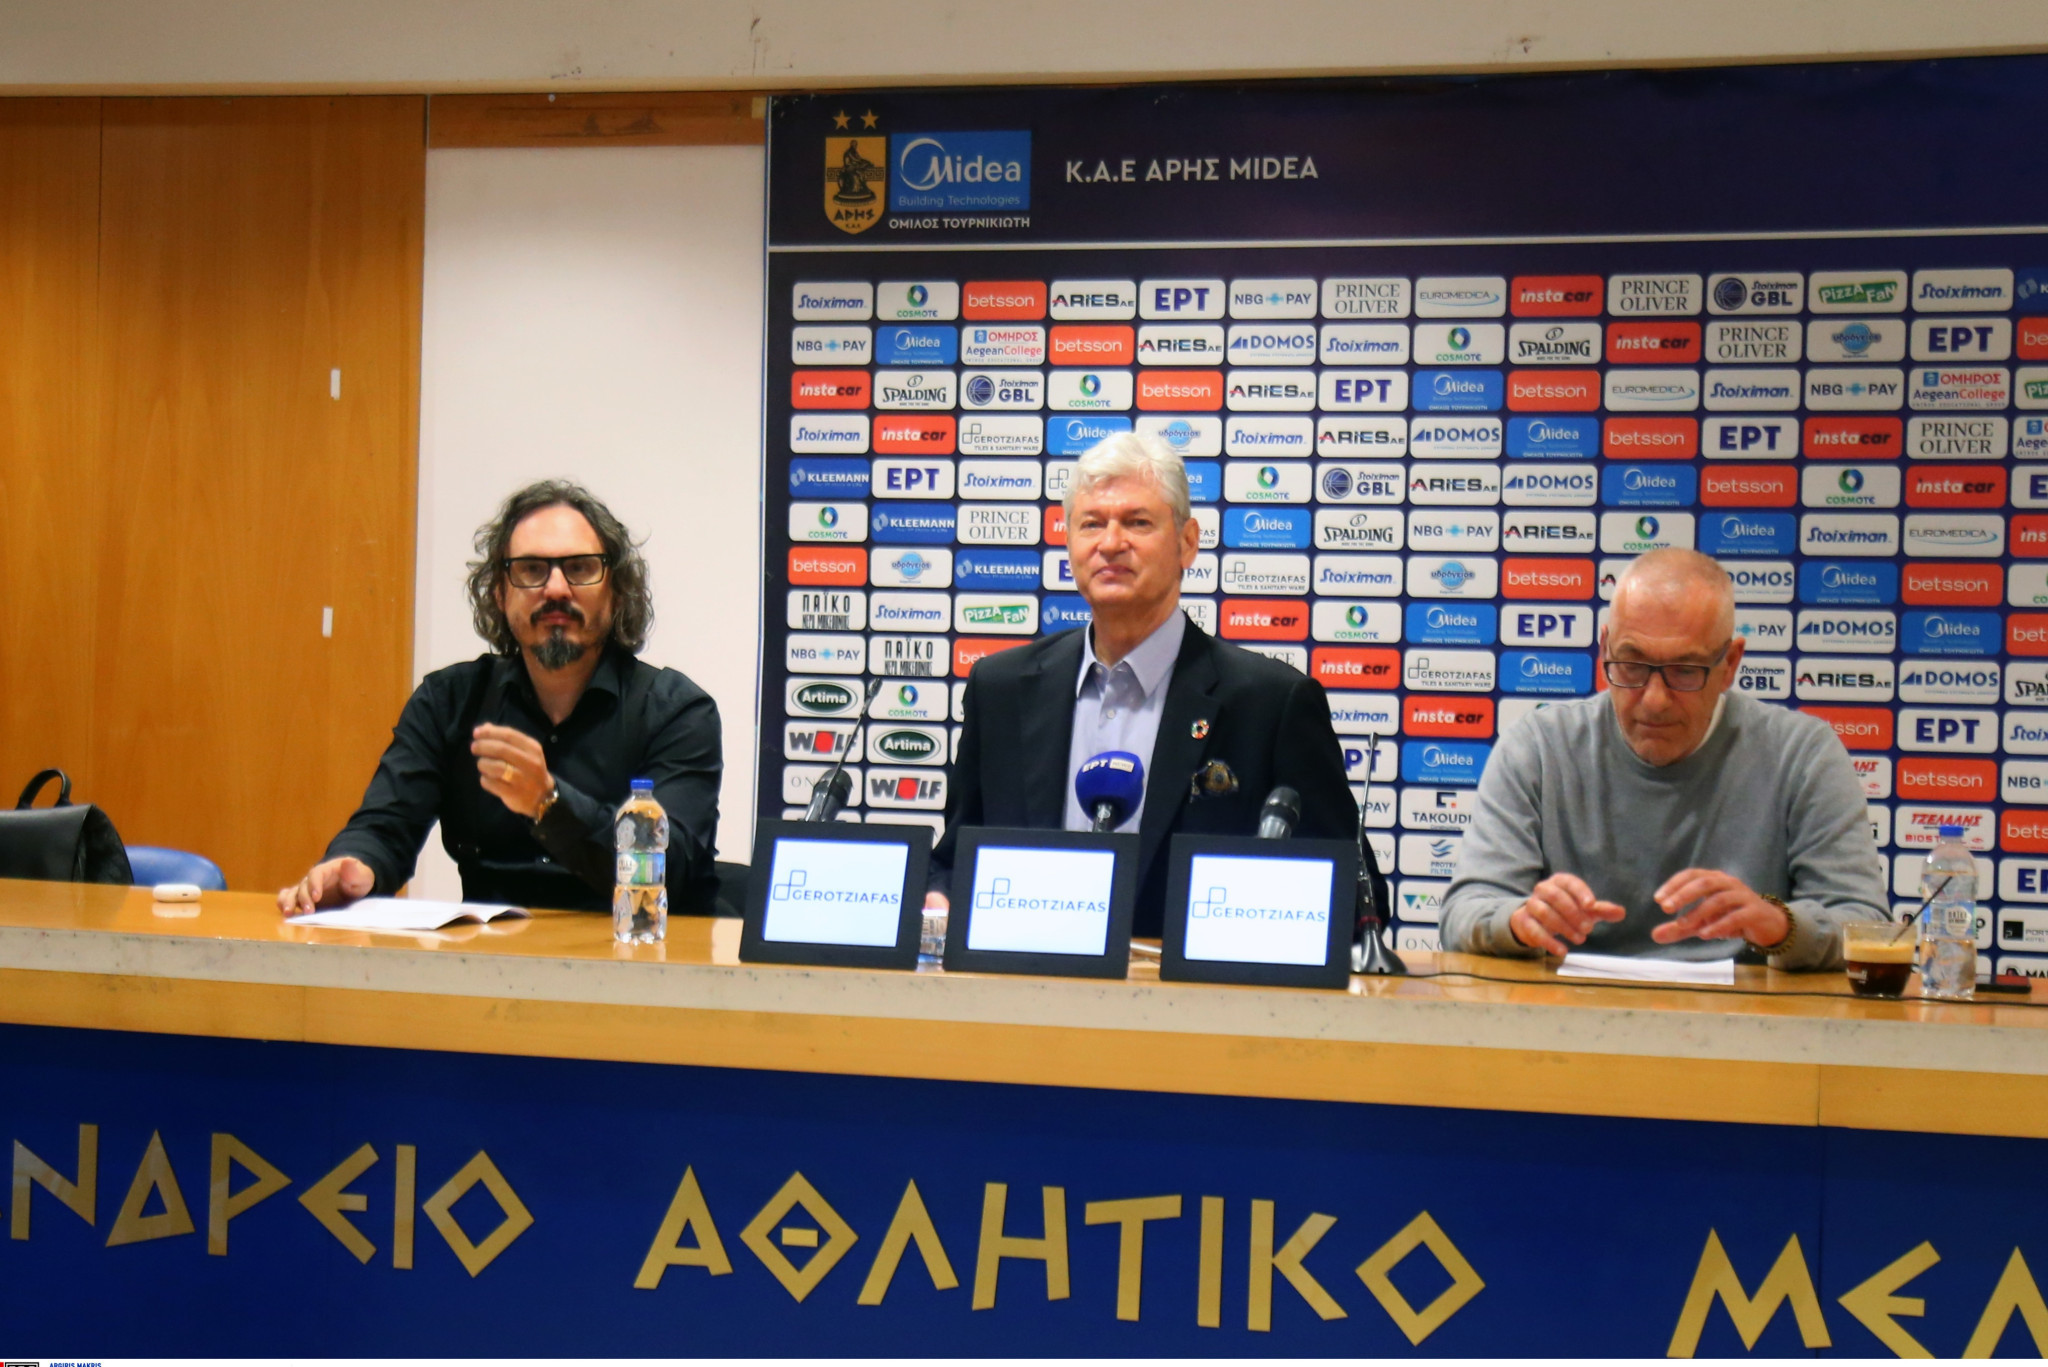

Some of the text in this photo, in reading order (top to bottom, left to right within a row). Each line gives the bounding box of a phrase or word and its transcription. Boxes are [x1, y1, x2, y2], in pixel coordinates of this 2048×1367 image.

[907, 142, 1021, 187] Midea
[1146, 159, 1220, 182] ΑΡΗΣ
[1230, 156, 1319, 179] MIDEA
[899, 195, 1020, 207] Building Technologies
[889, 217, 1030, 229] ΟΜΙΛΟΣ ΤΟΥΡΝΙΚΙΩΤΗ
[1336, 284, 1400, 298] PRINCE
[1622, 281, 1689, 294] PRINCE
[1919, 284, 2003, 299] Stoiximan
[798, 293, 864, 309] Stoiximan
[968, 294, 1034, 308] betsson
[1154, 288, 1210, 312] ΕΡΤ
[1235, 293, 1311, 305] NBG PAY
[1420, 291, 1490, 301] EUROMEDICA
[1521, 289, 1593, 302] instacar
[1751, 292, 1793, 306] GBL
[1335, 300, 1398, 314] OLIVER
[1621, 297, 1688, 311] OLIVER
[897, 310, 938, 318] COSMOTE
[898, 332, 940, 349] Midea
[988, 332, 1038, 342] ΟΜΗΡΟΣ
[1720, 327, 1789, 342] PRINCE
[1929, 327, 1993, 353] ΕΡΤ
[797, 340, 866, 351] NBG PAY
[1055, 339, 1122, 352] betsson
[1251, 336, 1314, 349] DOMOS
[1326, 338, 1399, 353] Stoiximan
[1518, 340, 1590, 357] SPALDING
[1616, 335, 1690, 349] instacar
[1436, 354, 1482, 362] COSMOTE
[1718, 344, 1787, 358] OLIVER
[1436, 376, 1484, 395] Midea
[1940, 373, 2001, 385] ΟΜΗΡΟΣ
[800, 383, 861, 396] instacar
[883, 386, 947, 403] SPALDING
[999, 389, 1034, 402] GBL
[1142, 384, 1211, 398] betsson
[1335, 380, 1392, 403] ΕΡΤ
[1513, 384, 1587, 398] betsson
[1710, 383, 1790, 398] Stoiximan
[1811, 384, 1897, 395] NBG PAY
[1069, 400, 1111, 408] COSMOTE
[796, 428, 860, 442] Stoiximan
[882, 428, 946, 442] instacar
[1434, 428, 1500, 442] DOMOS
[1529, 422, 1579, 441] Midea
[1814, 430, 1891, 444] instacar
[1922, 423, 1993, 437] PRINCE
[1232, 430, 1304, 445] Stoiximan
[1610, 431, 1684, 445] betsson
[1720, 426, 1781, 450] ΕΡΤ
[1920, 440, 1991, 454] OLIVER
[808, 473, 869, 483] KLEEMANN
[888, 468, 939, 490] ΕΡΤ
[964, 473, 1032, 488] Stoiximan
[1527, 475, 1593, 489] DOMOS
[1625, 470, 1675, 489] Midea
[1357, 482, 1395, 496] GBL
[1707, 479, 1783, 493] betsson
[1916, 479, 1995, 493] instacar
[1246, 492, 1289, 500] COSMOTE
[891, 519, 954, 529] KLEEMANN
[970, 512, 1029, 525] PRINCE
[1246, 514, 1292, 531] Midea
[808, 531, 848, 539] COSMOTE
[969, 526, 1028, 540] OLIVER
[1324, 525, 1393, 543] SPALDING
[1414, 525, 1493, 538] NBG PAY
[1722, 518, 1775, 538] Midea
[1807, 527, 1887, 543] Stoiximan
[793, 559, 856, 572] betsson
[975, 565, 1039, 575] KLEEMANN
[1187, 569, 1212, 579] PAY
[1238, 575, 1305, 583] GEROTZIAFAS
[1320, 569, 1393, 584] Stoiximan
[1508, 572, 1581, 586] betsson
[1824, 567, 1876, 586] Midea
[1909, 577, 1988, 592] betsson
[876, 605, 941, 620] Stoiximan
[1229, 612, 1298, 626] instacar
[1428, 609, 1477, 627] Midea
[1517, 614, 1576, 638] ΕΡΤ
[1758, 625, 1786, 636] PAY
[1825, 621, 1894, 636] DOMOS
[1926, 617, 1980, 637] Midea
[1335, 631, 1379, 639] COSMOTE
[792, 649, 860, 660] NBG PAY
[1321, 660, 1390, 675] instacar
[1522, 657, 1572, 676] Midea
[1421, 671, 1492, 680] GEROTZIAFAS
[1925, 671, 1998, 687] DOMOS
[1739, 676, 1780, 690] GBL
[802, 692, 848, 704] Artima
[1331, 710, 1389, 722] oiximan
[1413, 709, 1483, 725] instacar
[1916, 718, 1980, 744] ΕΡΤ
[884, 739, 931, 751] Artima
[1345, 749, 1381, 772] ΡΤ
[1425, 747, 1473, 766] Midea
[1903, 771, 1983, 788] betsson
[2008, 776, 2041, 788] NBG
[1413, 812, 1472, 824] TAKOUDI
[791, 889, 899, 905] GEROTZIAFAS
[995, 897, 1106, 913] GEROTZIAFAS
[1212, 907, 1326, 923] GEROTZIAFAS
[5, 1123, 535, 1278] ΝΔΡΕΙΟ
[633, 1164, 1486, 1347] ΑΘΛΗΤΙΚΟ
